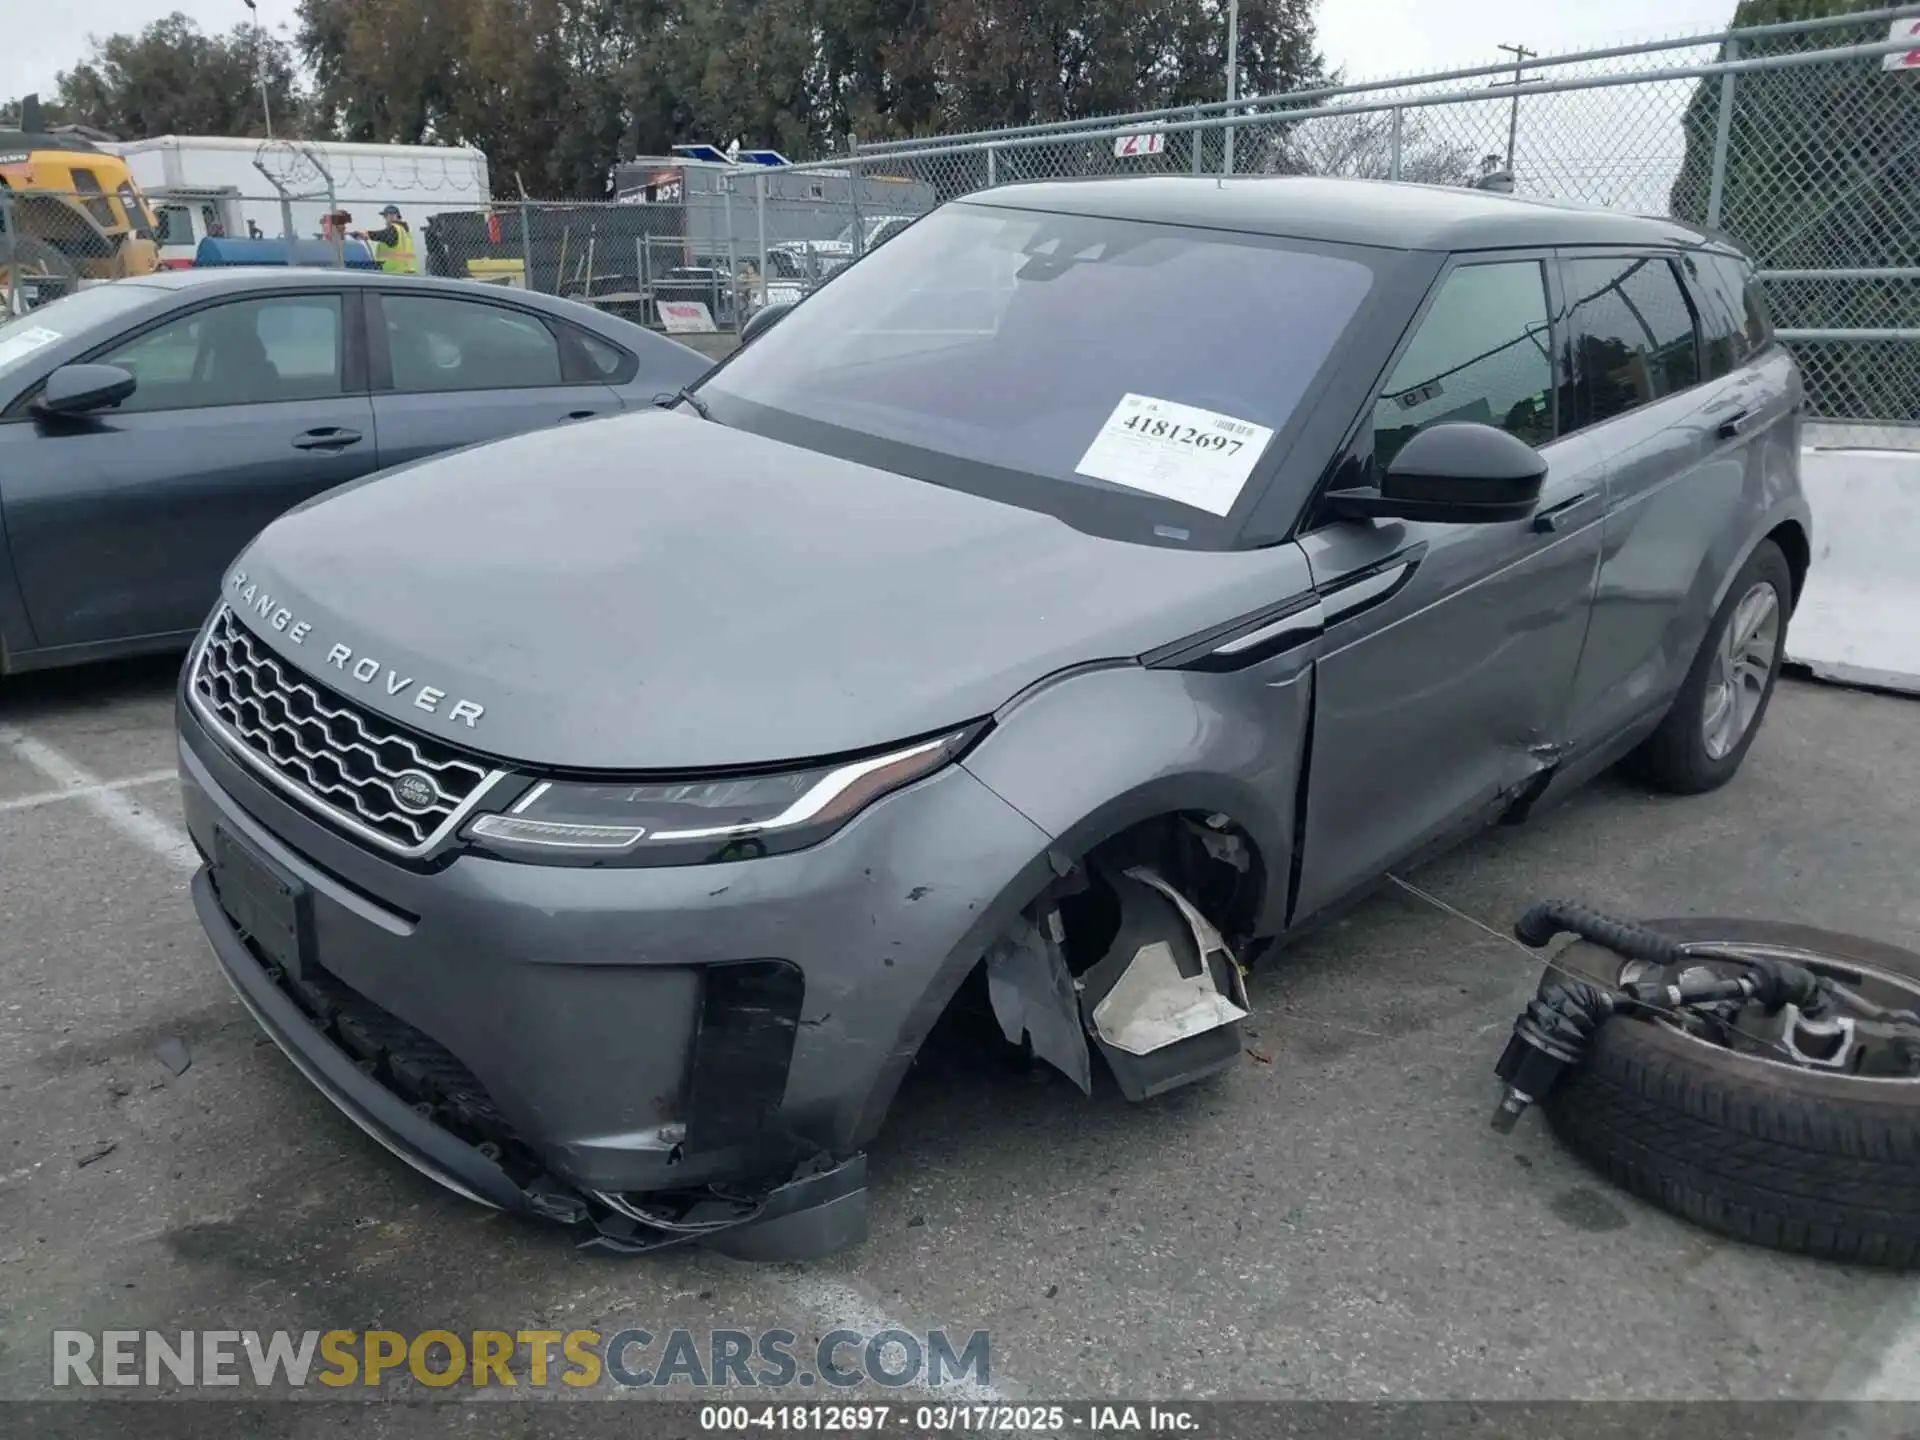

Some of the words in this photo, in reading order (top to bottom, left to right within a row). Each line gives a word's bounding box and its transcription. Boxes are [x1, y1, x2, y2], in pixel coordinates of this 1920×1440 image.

[1124, 415, 1244, 457] 41812697
[232, 572, 312, 643] RANGE
[327, 643, 485, 728] ROVER
